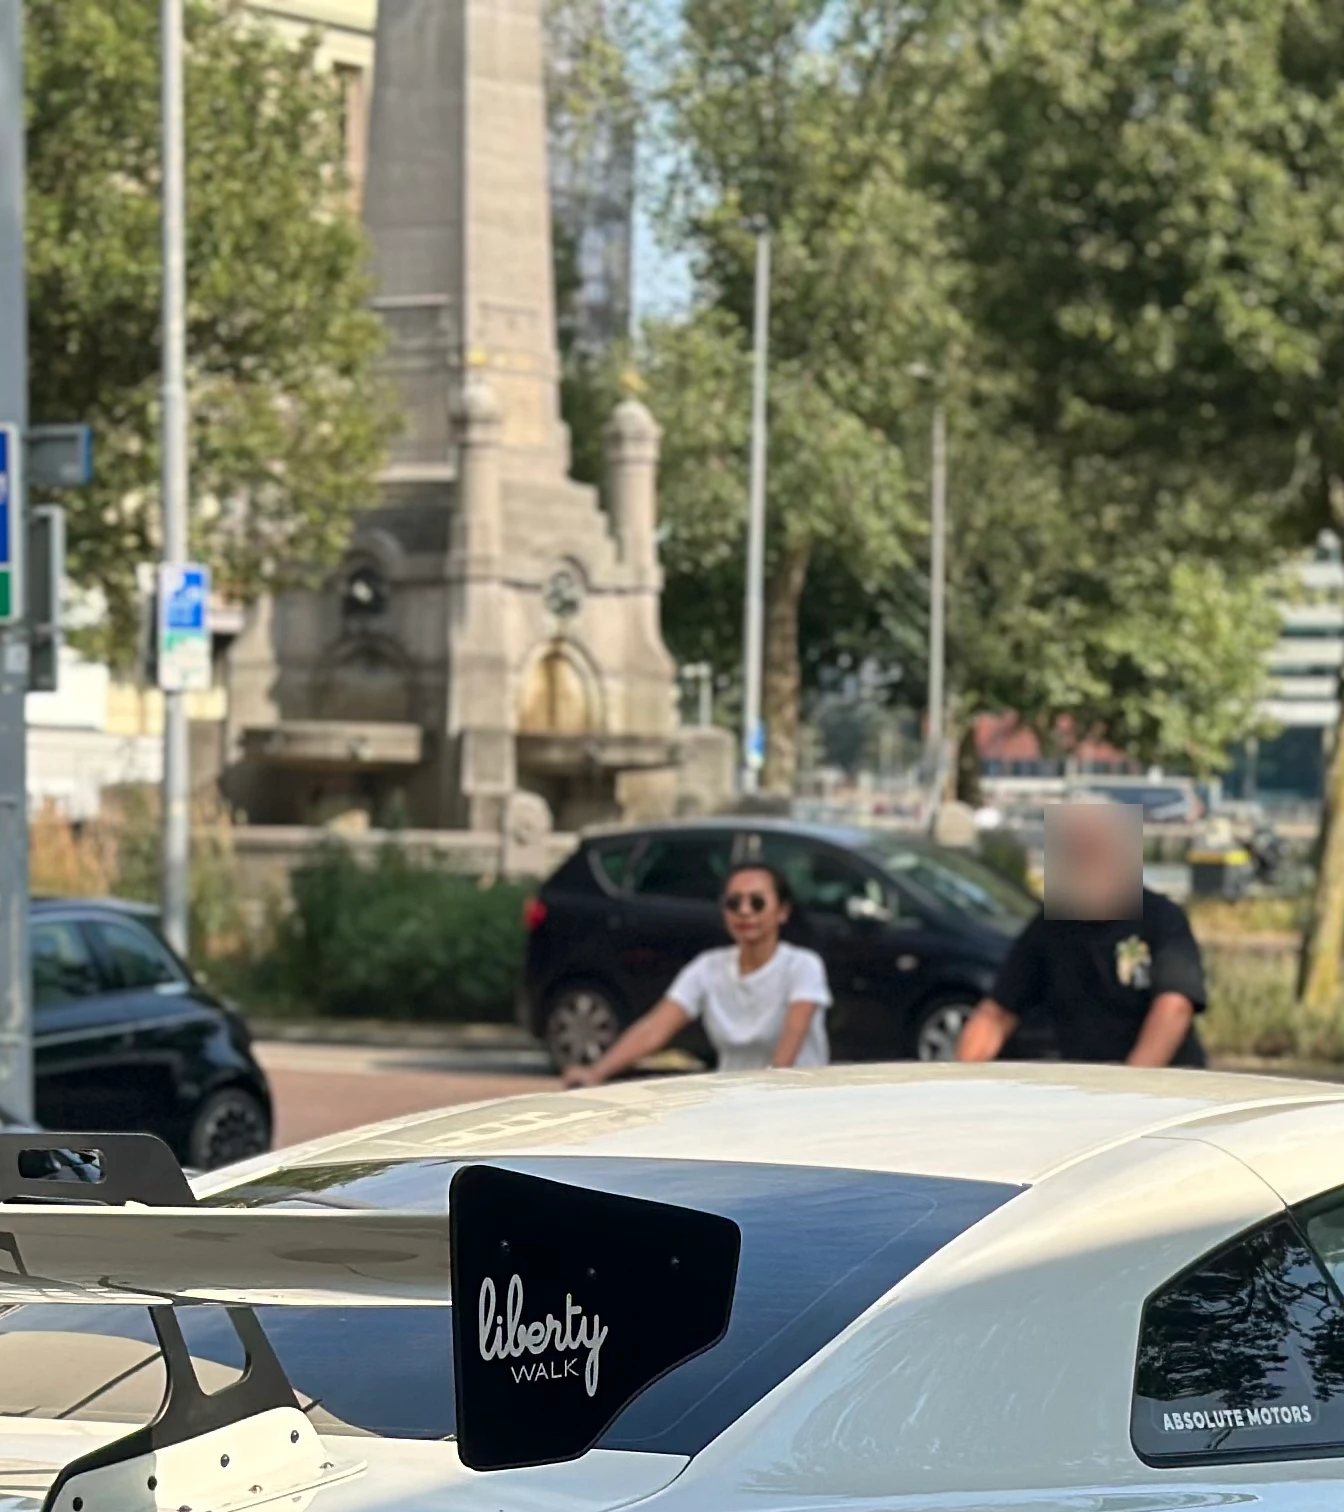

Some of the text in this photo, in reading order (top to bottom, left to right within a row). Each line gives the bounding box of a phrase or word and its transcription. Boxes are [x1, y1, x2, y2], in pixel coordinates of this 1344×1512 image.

[478, 1273, 609, 1397] liberty
[510, 1357, 580, 1384] WALK
[1163, 1404, 1312, 1431] ABSOLUTE MOTORS
